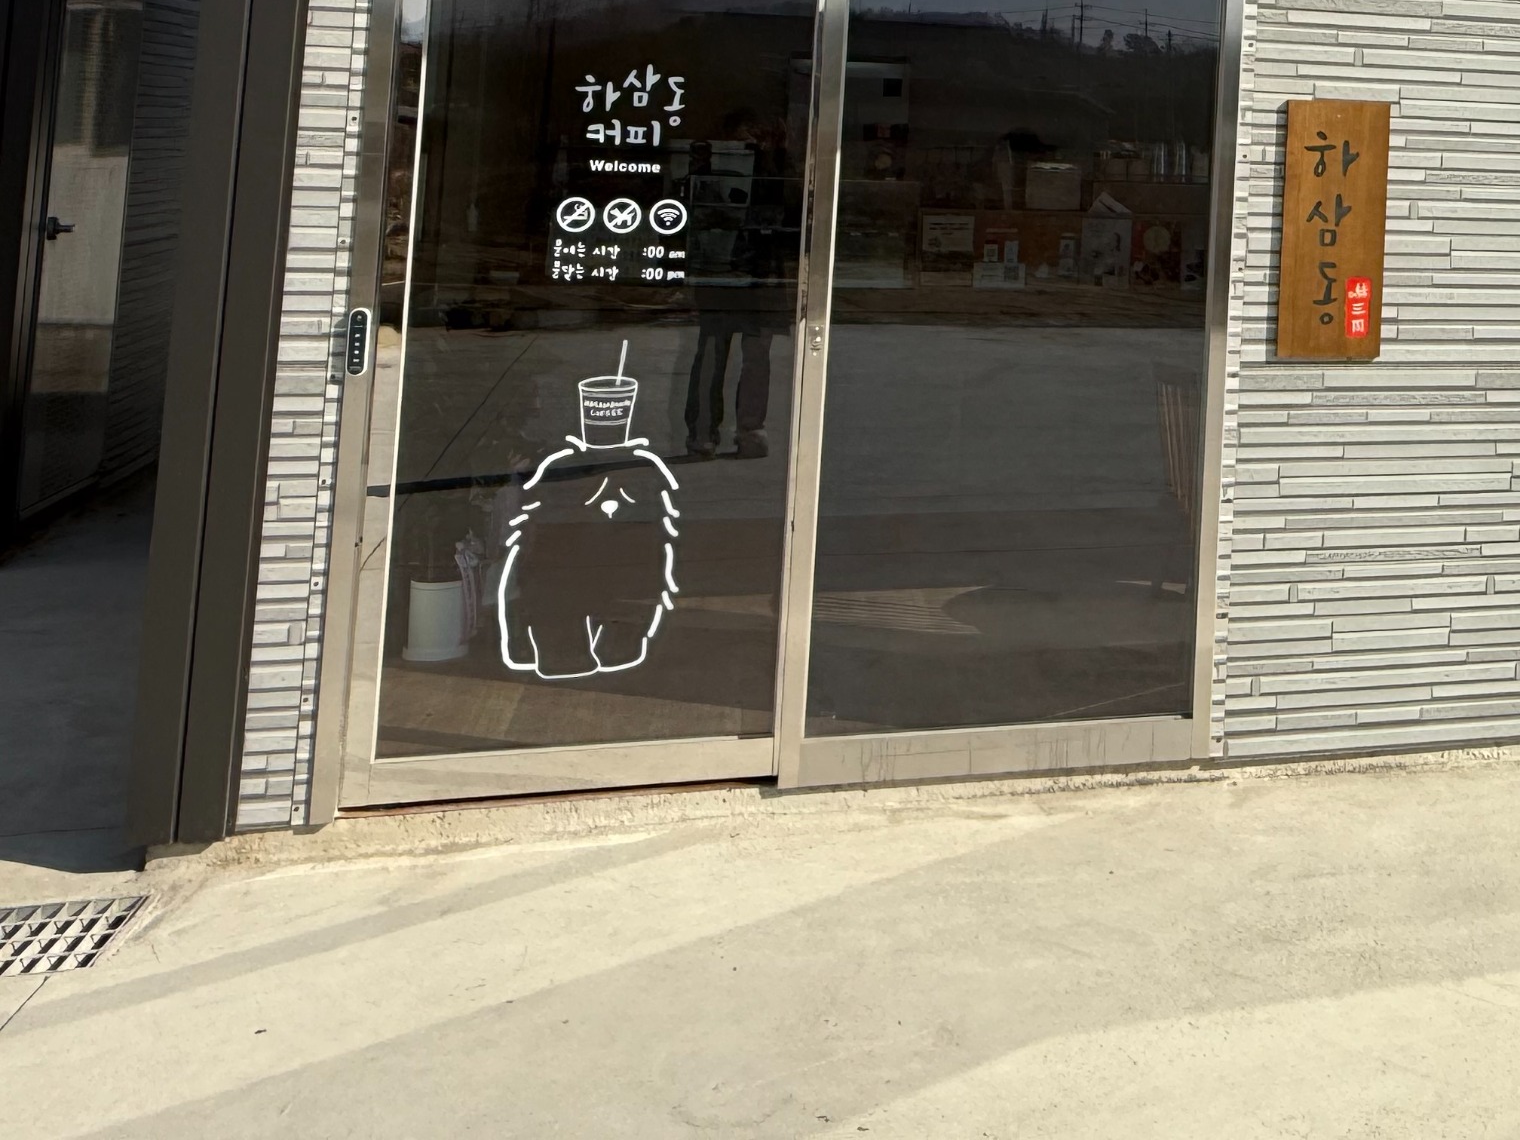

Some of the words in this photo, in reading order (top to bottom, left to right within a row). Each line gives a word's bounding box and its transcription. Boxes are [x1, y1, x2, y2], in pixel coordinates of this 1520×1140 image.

[575, 63, 686, 127] 하삼동
[586, 119, 661, 147] 커피
[589, 159, 661, 173] Welcome
[1304, 130, 1360, 325] 하삼동
[592, 245, 621, 259] 시간
[552, 260, 585, 281] 문닫는
[591, 266, 619, 281] 시간
